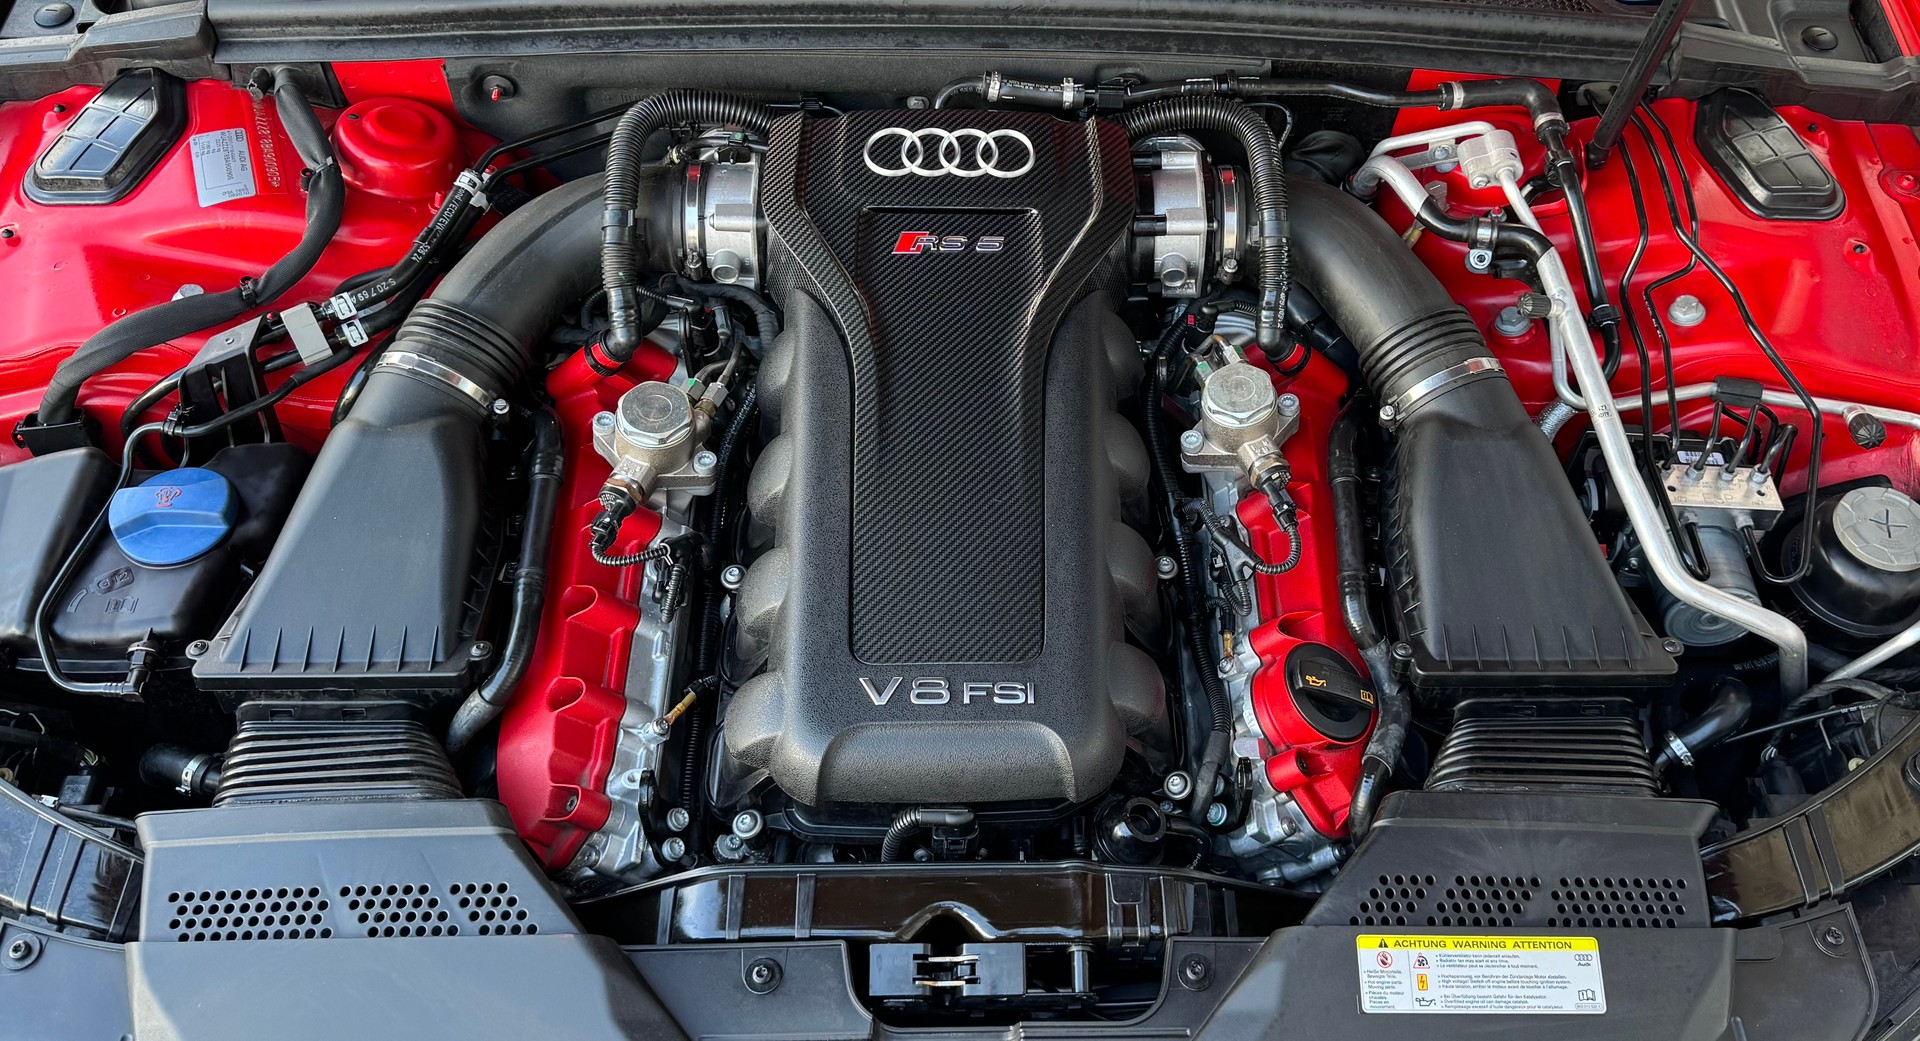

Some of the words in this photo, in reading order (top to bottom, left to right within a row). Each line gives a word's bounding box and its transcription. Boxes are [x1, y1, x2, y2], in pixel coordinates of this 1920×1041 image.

[238, 150, 247, 163] AUDI
[239, 163, 248, 172] AG
[909, 235, 968, 251] RS
[975, 235, 1005, 252] 5
[1702, 492, 1734, 505] ESP
[859, 676, 951, 706] V8
[963, 682, 1035, 704] FSI
[1393, 939, 1447, 949] ACHTUNG
[1453, 940, 1507, 949] WARNING
[1512, 940, 1572, 950] ATTENTION
